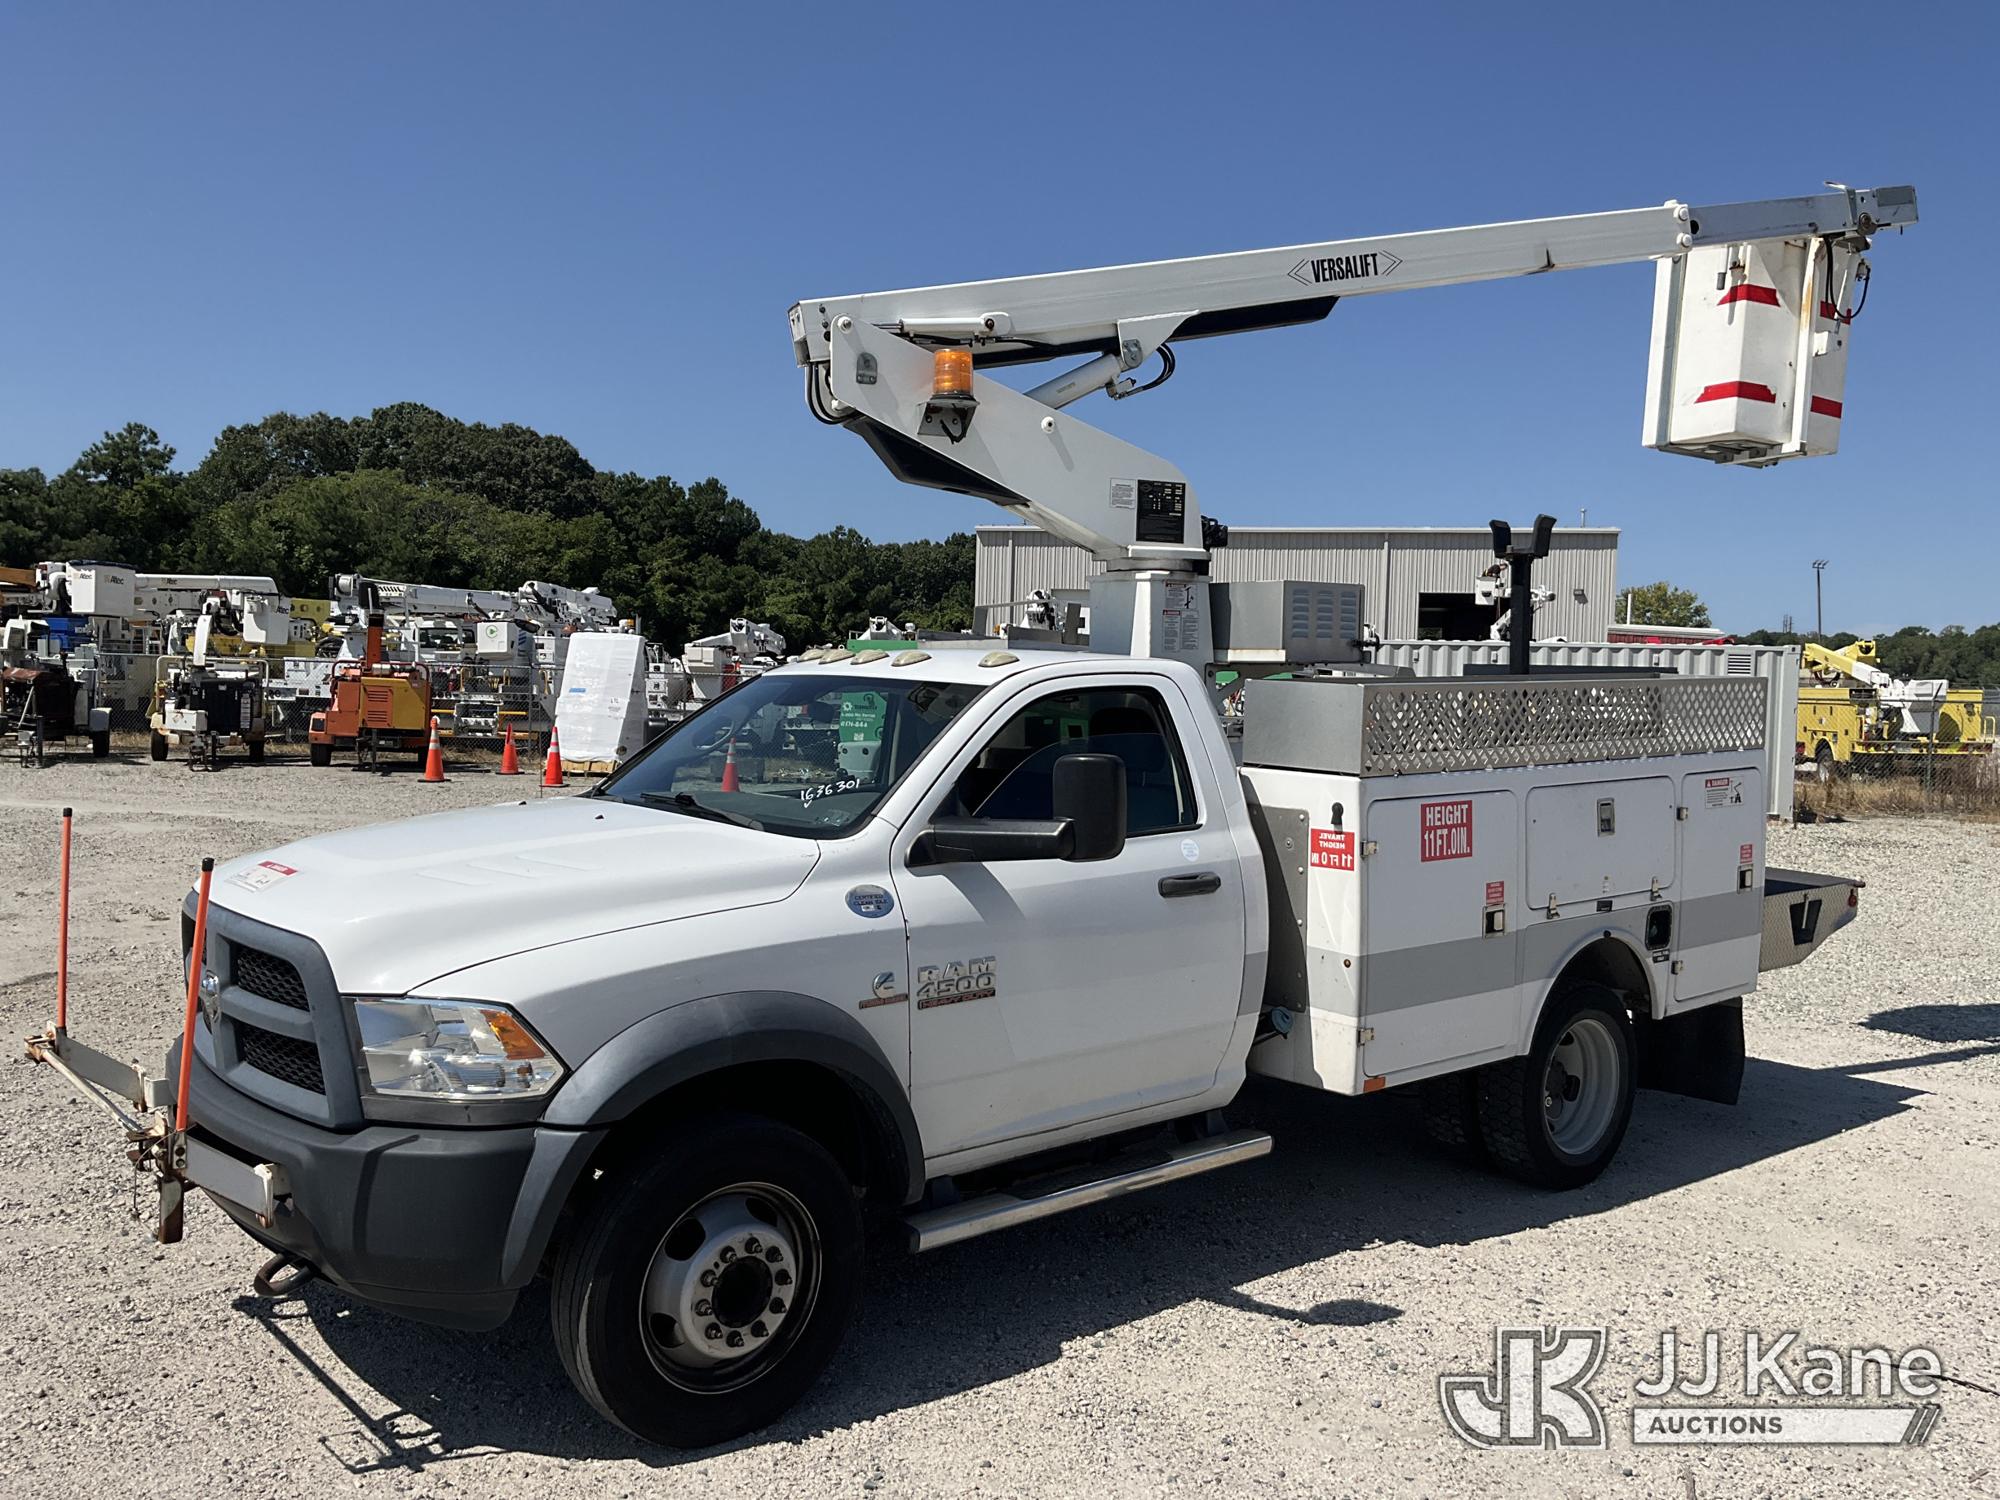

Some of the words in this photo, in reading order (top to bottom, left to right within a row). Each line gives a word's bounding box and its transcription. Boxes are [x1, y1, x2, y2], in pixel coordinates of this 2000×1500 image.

[1310, 253, 1378, 283] VERSALIFT
[1425, 804, 1468, 826] HEIGHT
[918, 955, 996, 983] RAM
[916, 972, 996, 999] 4500
